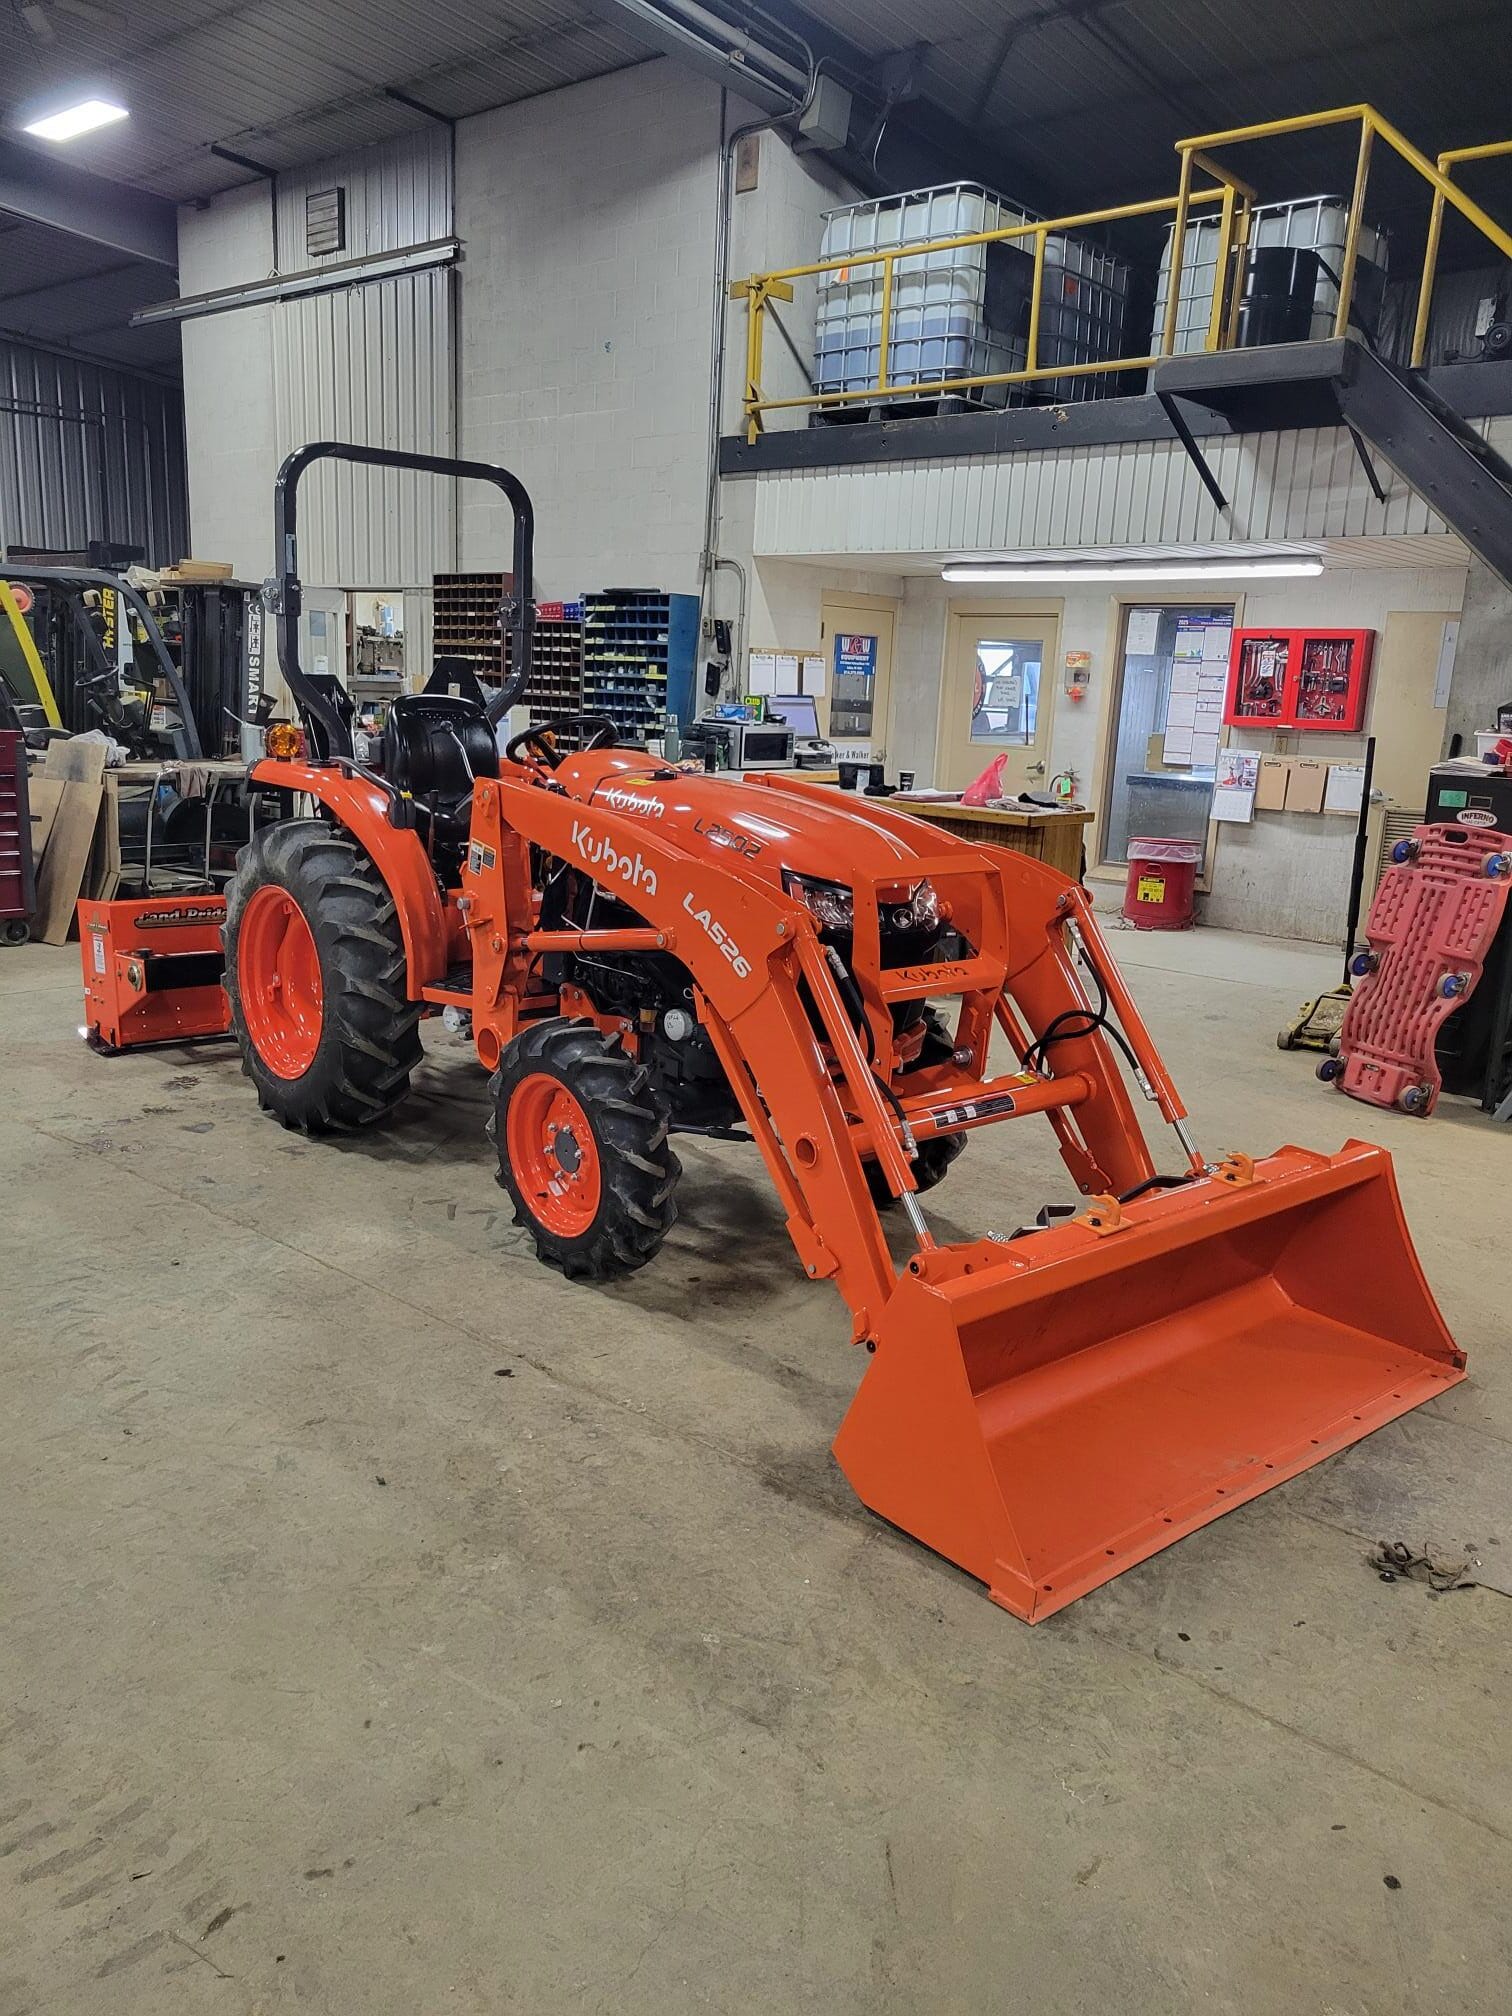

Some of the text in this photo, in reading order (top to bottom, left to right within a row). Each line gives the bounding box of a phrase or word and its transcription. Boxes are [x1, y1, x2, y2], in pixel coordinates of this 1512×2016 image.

[841, 635, 870, 654] W&W
[851, 751, 869, 759] Walker
[604, 787, 665, 818] Kubota
[1461, 812, 1495, 824] INFERNO
[693, 818, 762, 860] L2502
[571, 820, 658, 897] Kubota
[139, 910, 180, 921] Land
[682, 891, 753, 979] LA526
[895, 964, 969, 983] Kubota
